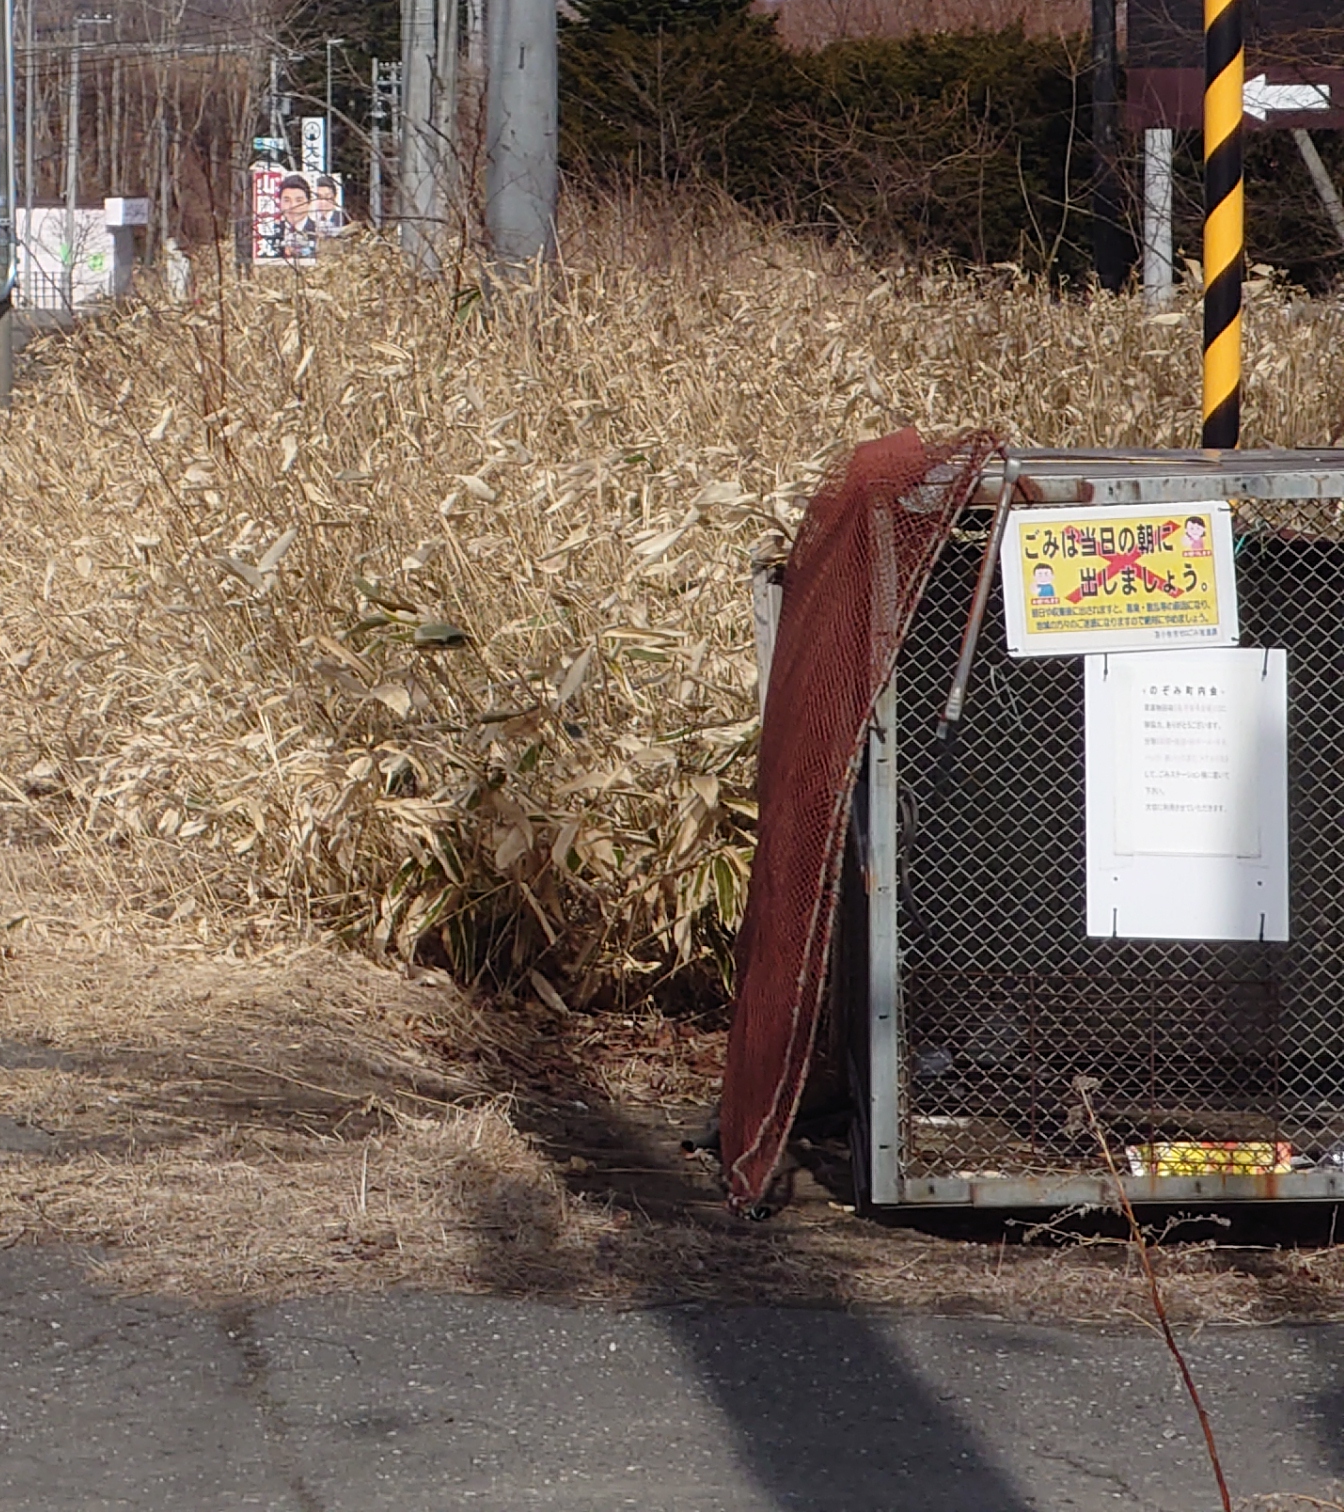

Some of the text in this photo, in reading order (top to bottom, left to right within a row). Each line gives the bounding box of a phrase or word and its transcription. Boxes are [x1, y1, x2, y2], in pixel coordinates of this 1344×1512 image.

[1025, 524, 1174, 559] ごみは当日の朝に
[1080, 563, 1208, 597] 出しましょう。
